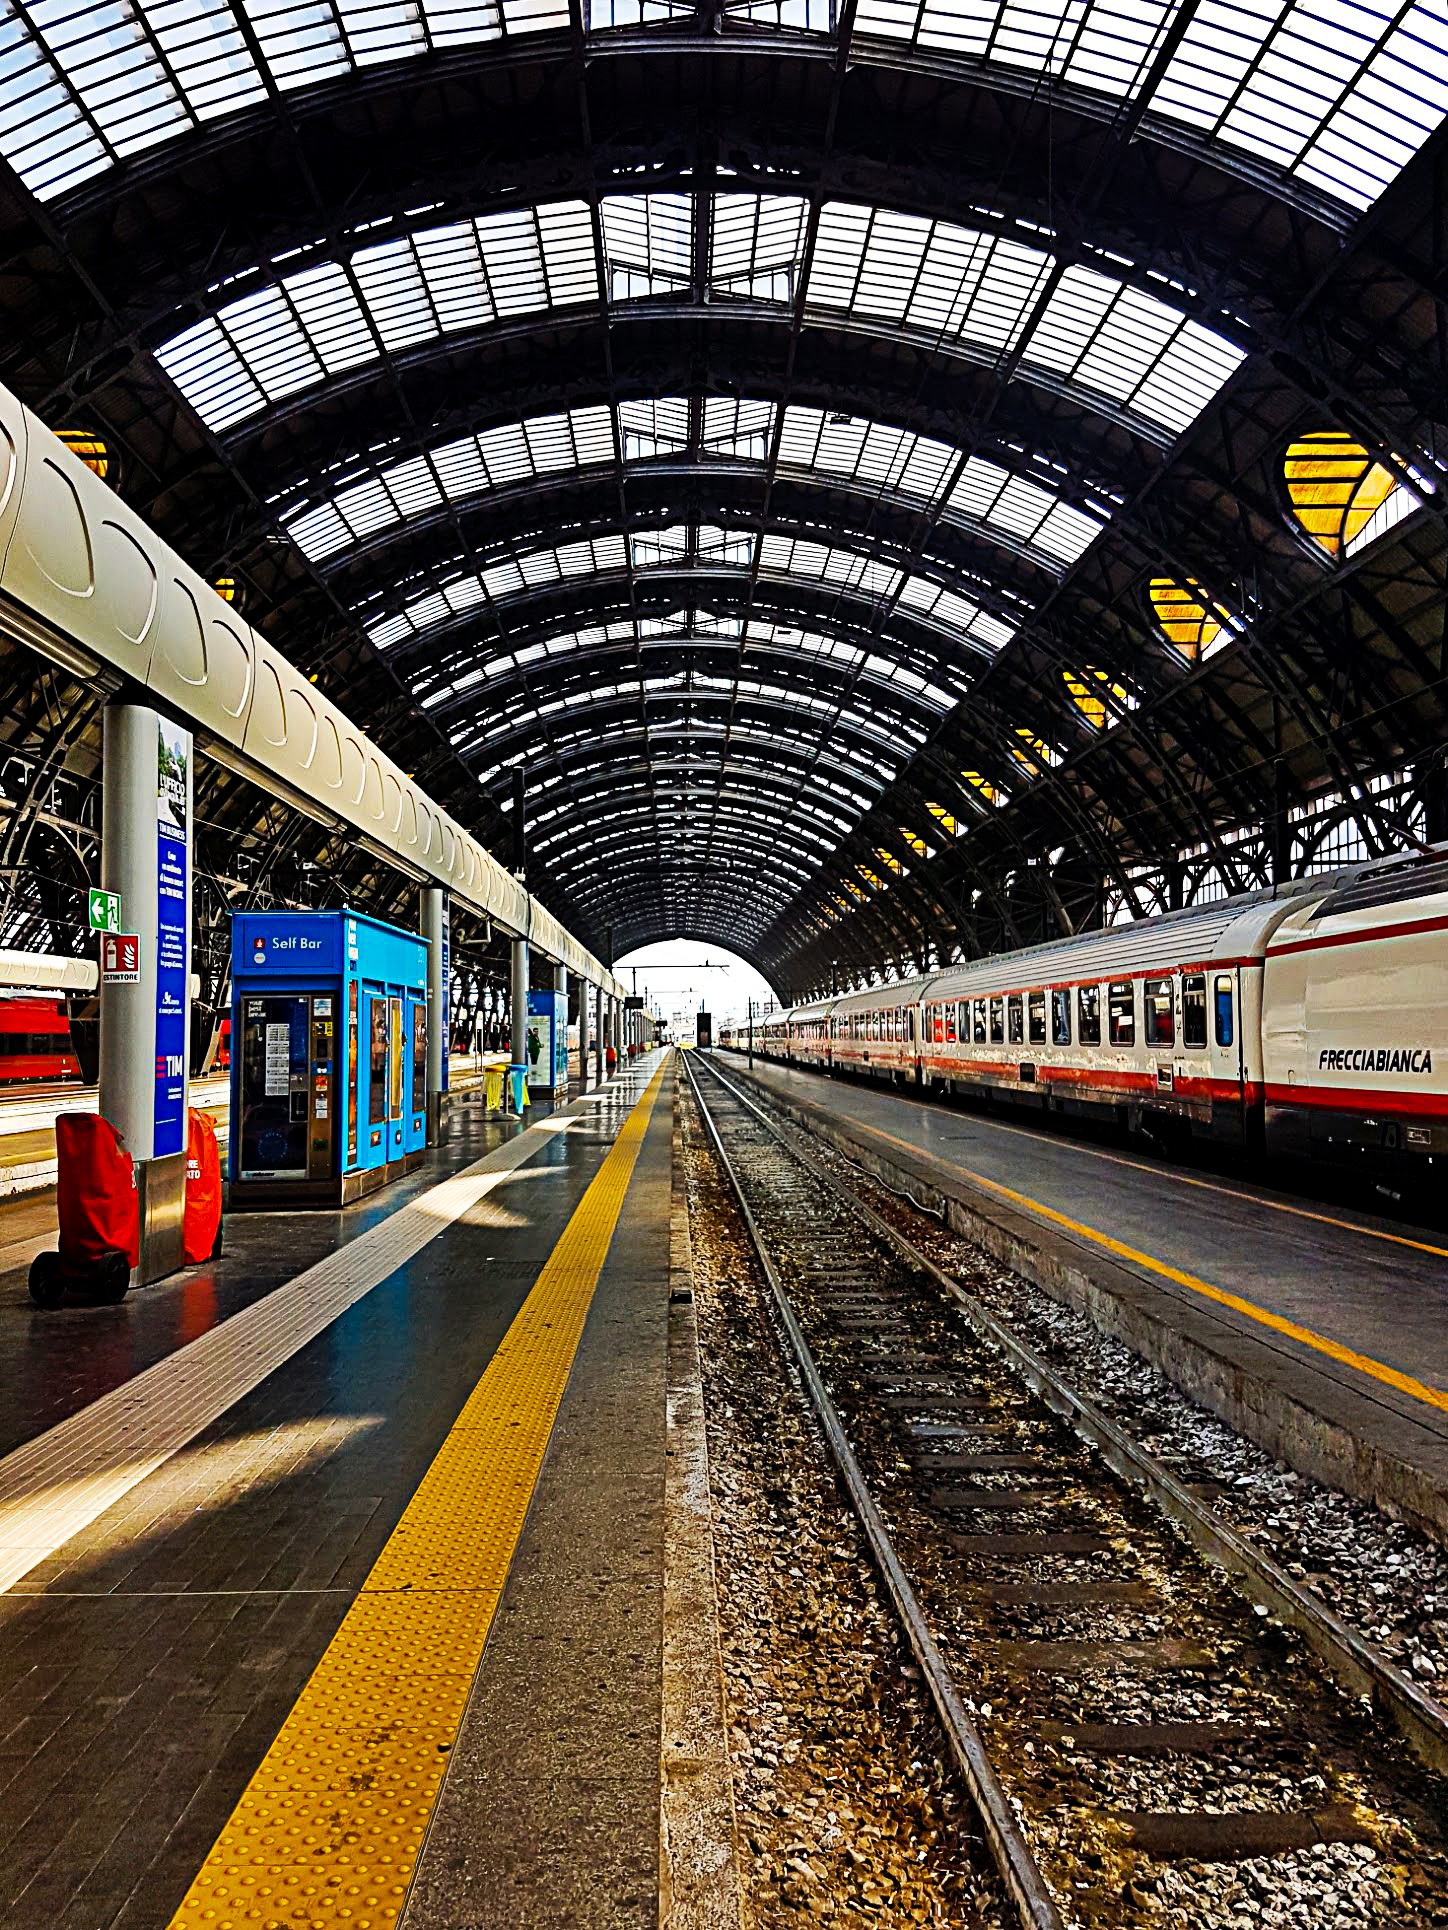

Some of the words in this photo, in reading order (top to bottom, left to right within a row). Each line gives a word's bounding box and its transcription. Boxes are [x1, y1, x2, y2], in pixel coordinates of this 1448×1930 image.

[272, 937, 297, 949] Self
[300, 937, 323, 949] Bar
[103, 973, 138, 981] ESTINTORE
[166, 1055, 183, 1077] TIM
[1318, 1049, 1433, 1074] FRECCIABIANCA
